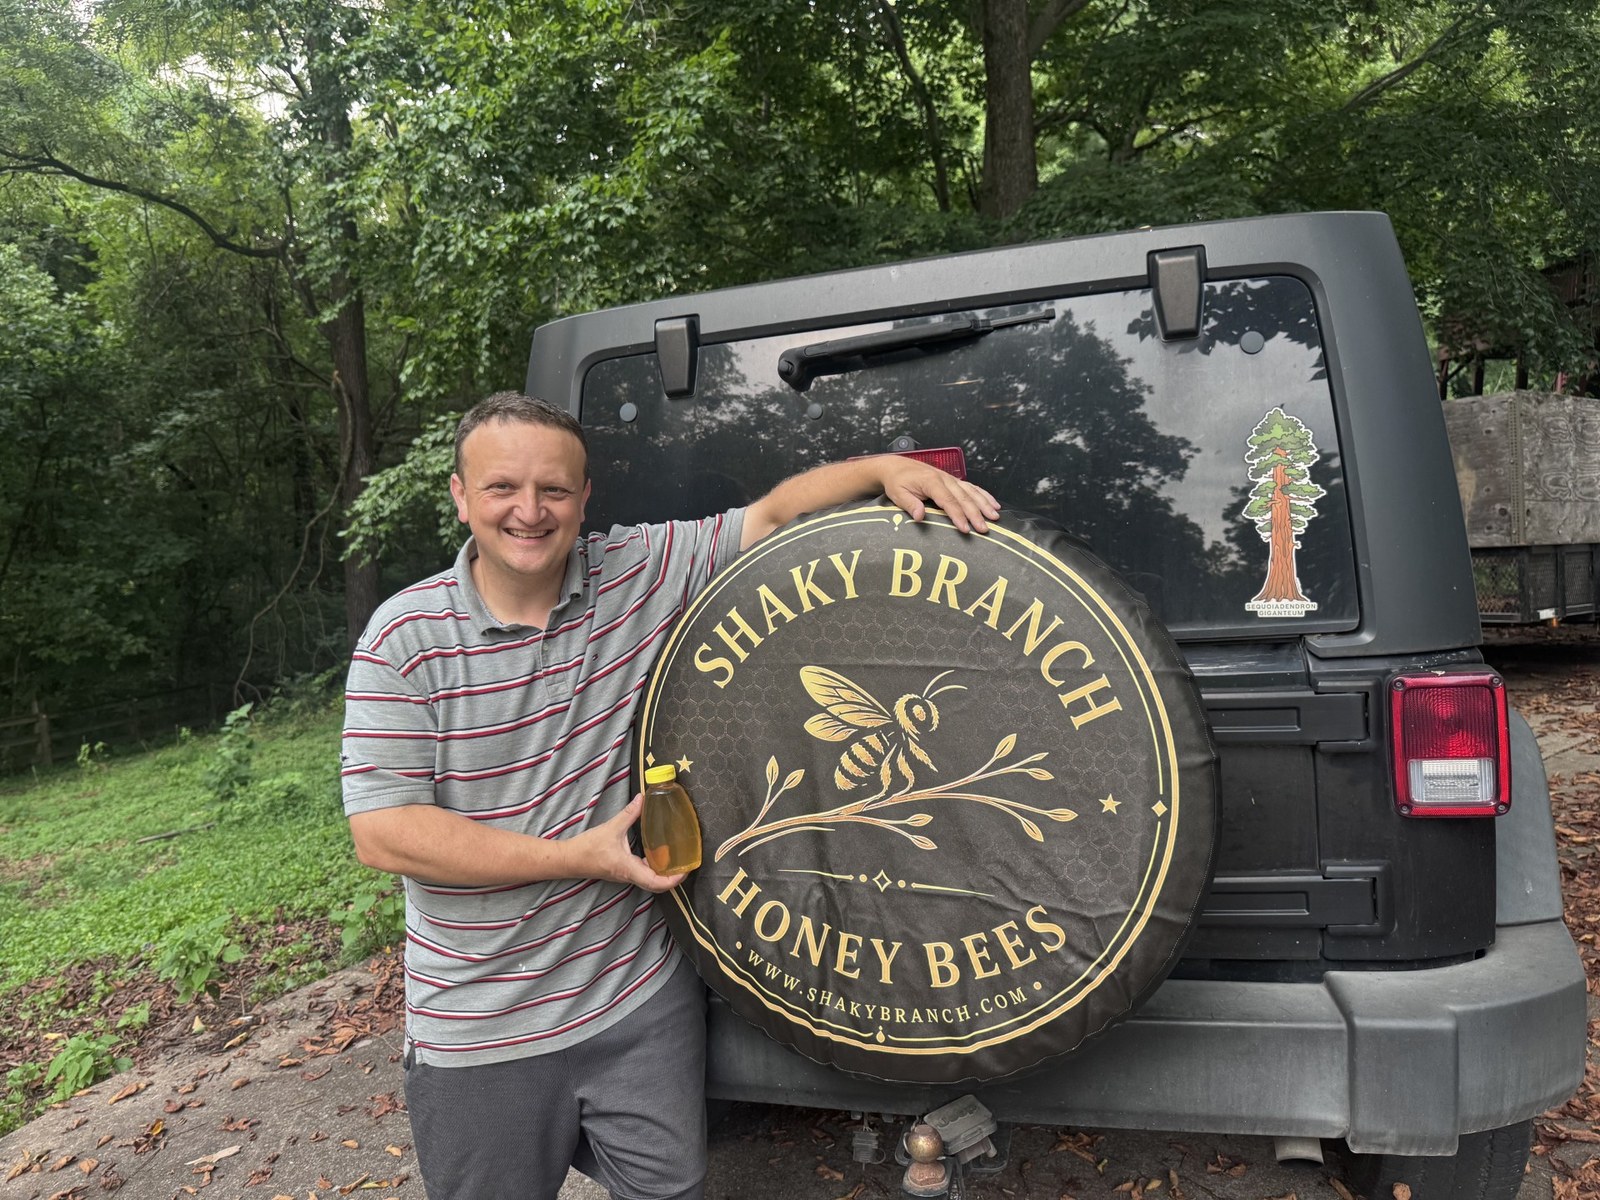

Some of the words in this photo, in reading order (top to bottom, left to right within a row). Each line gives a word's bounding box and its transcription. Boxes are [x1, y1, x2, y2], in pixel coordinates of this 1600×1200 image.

[694, 549, 863, 688] SHAKY
[890, 548, 1122, 730] BRANCH
[716, 867, 902, 984] HONEY
[923, 904, 1067, 988] BEES
[748, 949, 1027, 1023] WWW.SHAKYBRANCH.COM
